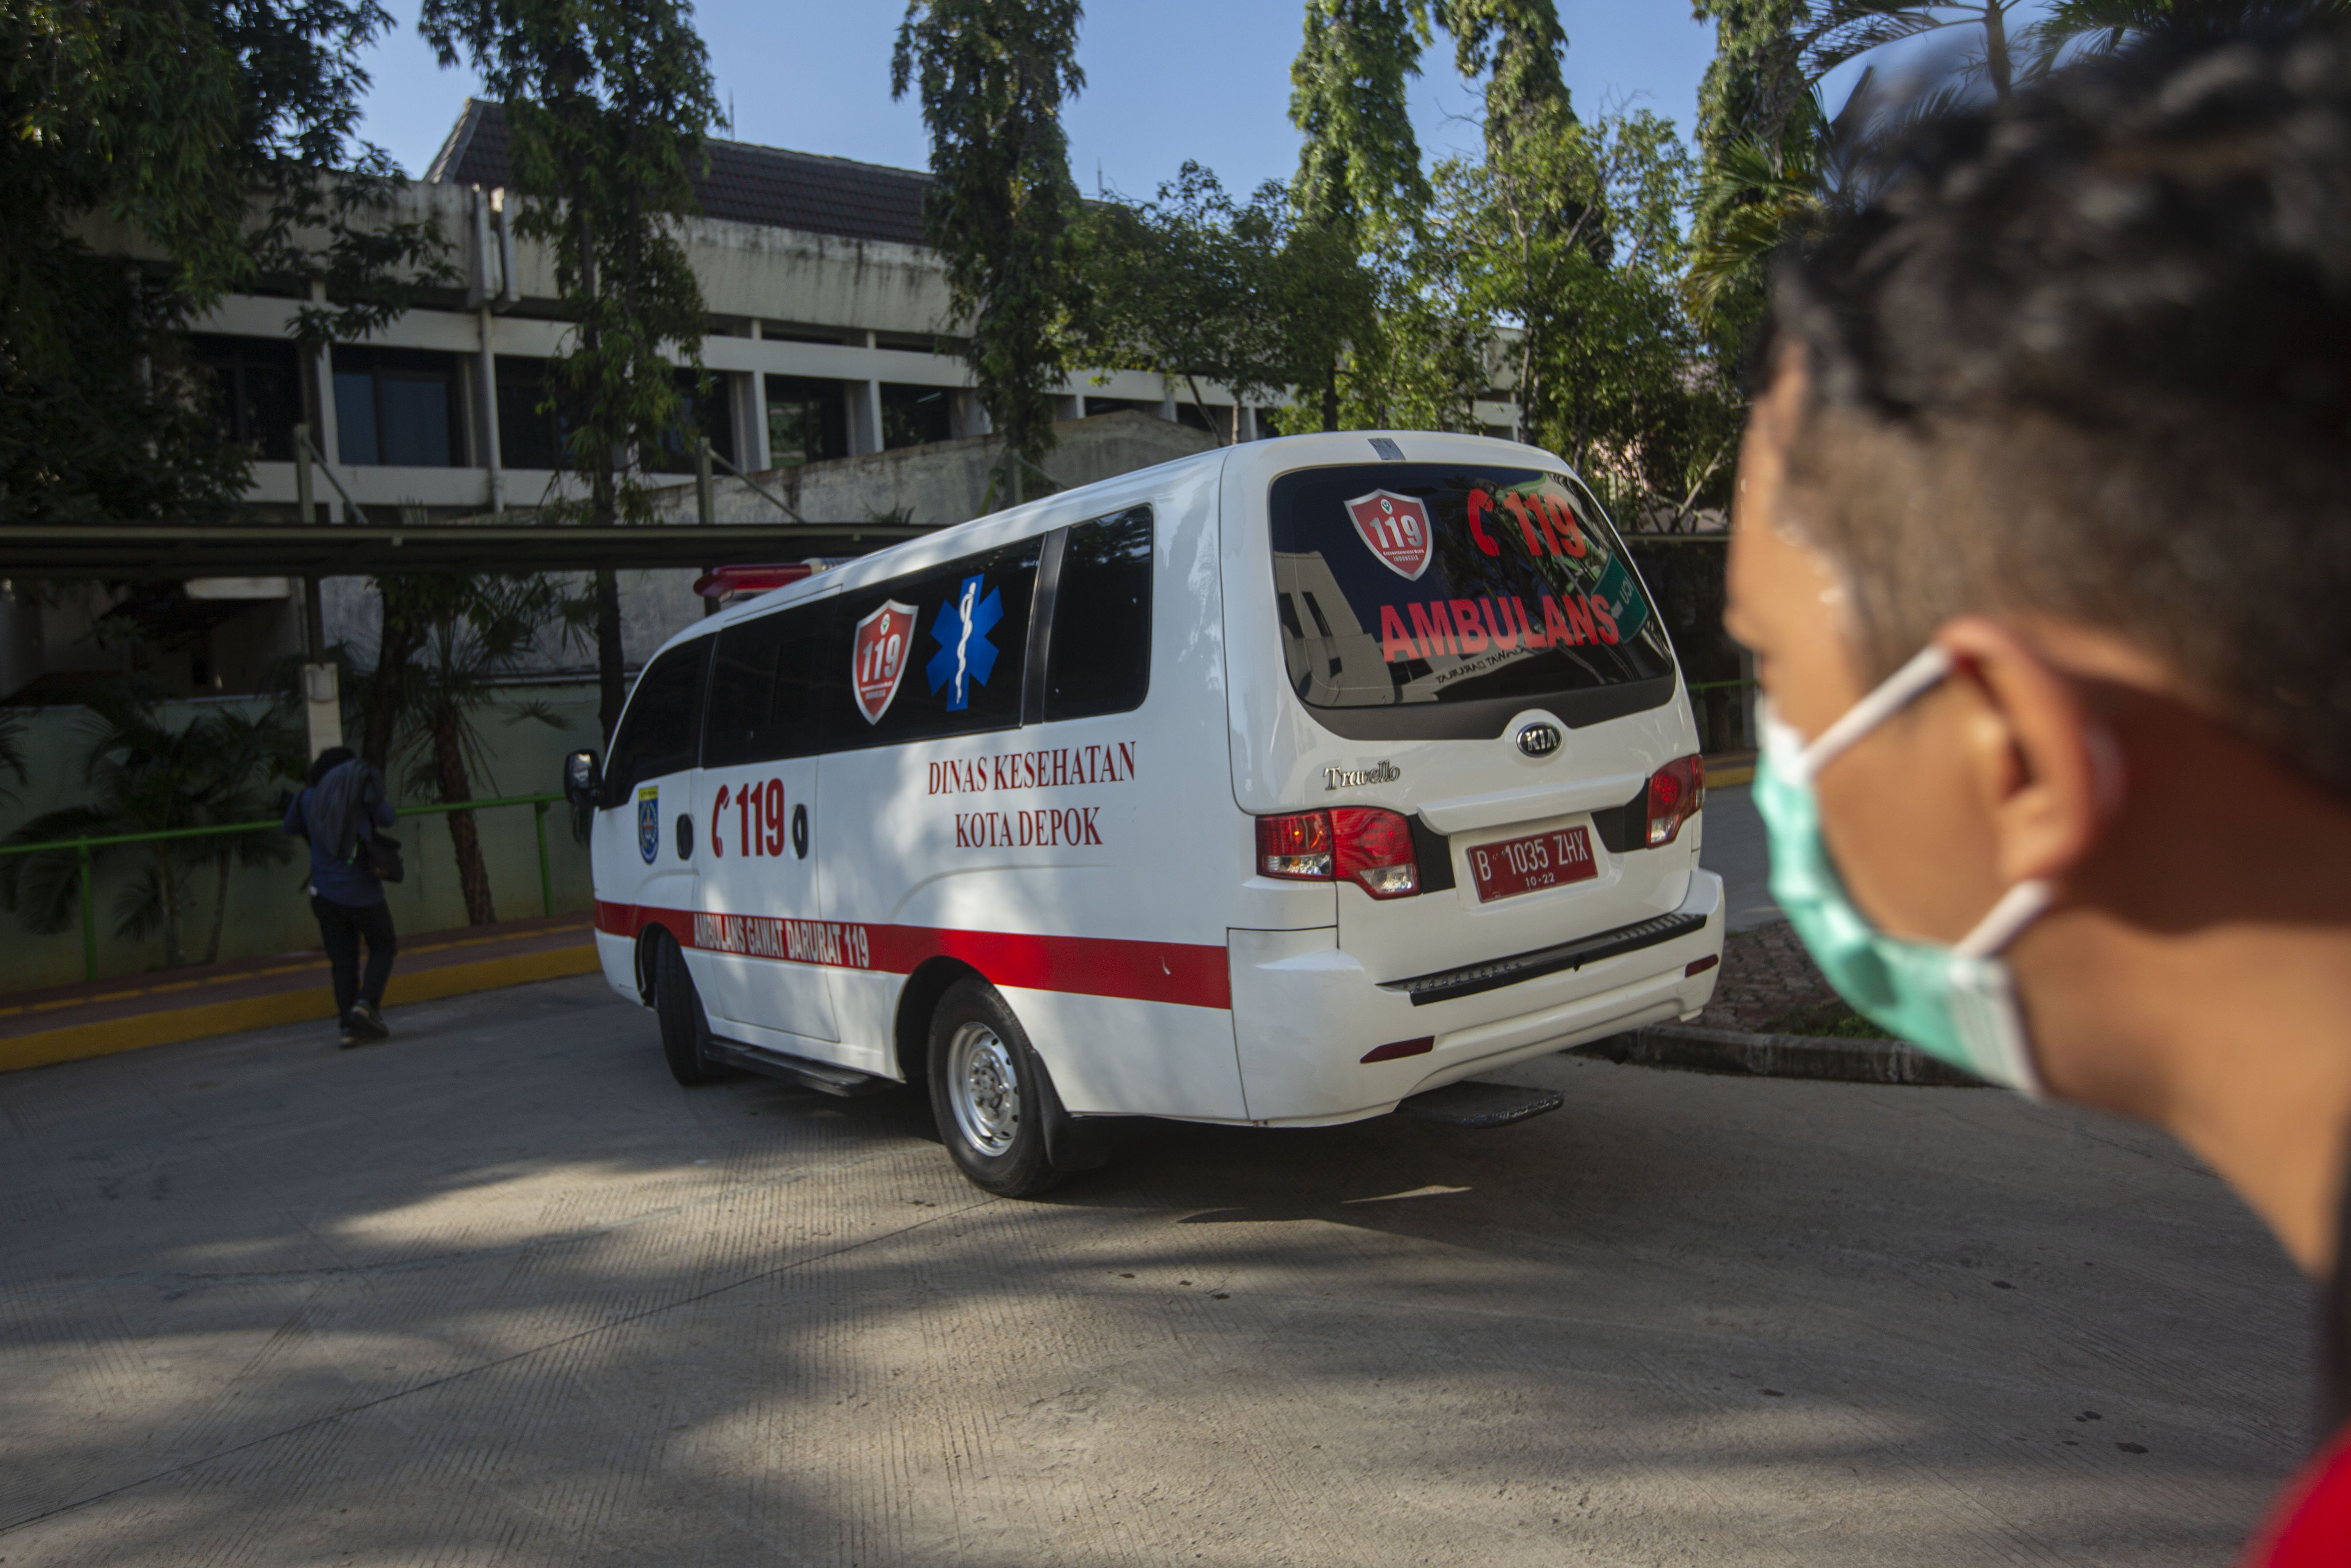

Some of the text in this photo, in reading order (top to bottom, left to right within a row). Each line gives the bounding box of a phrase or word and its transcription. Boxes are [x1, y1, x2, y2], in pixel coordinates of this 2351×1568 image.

[1369, 515, 1422, 548] 119
[1503, 491, 1586, 558] 119
[1380, 595, 1619, 662] AMBULANS
[862, 633, 901, 683] 119
[1525, 729, 1557, 751] KIA
[928, 741, 1136, 795] DINAS KESEHATAN
[1323, 759, 1401, 791] Travello
[736, 778, 785, 857] 119
[955, 807, 1103, 848] KOTA DEPOK
[1477, 831, 1588, 881] B 1035 ZHX
[694, 912, 869, 968] AMBULANS GAWAT DARURAT 119
